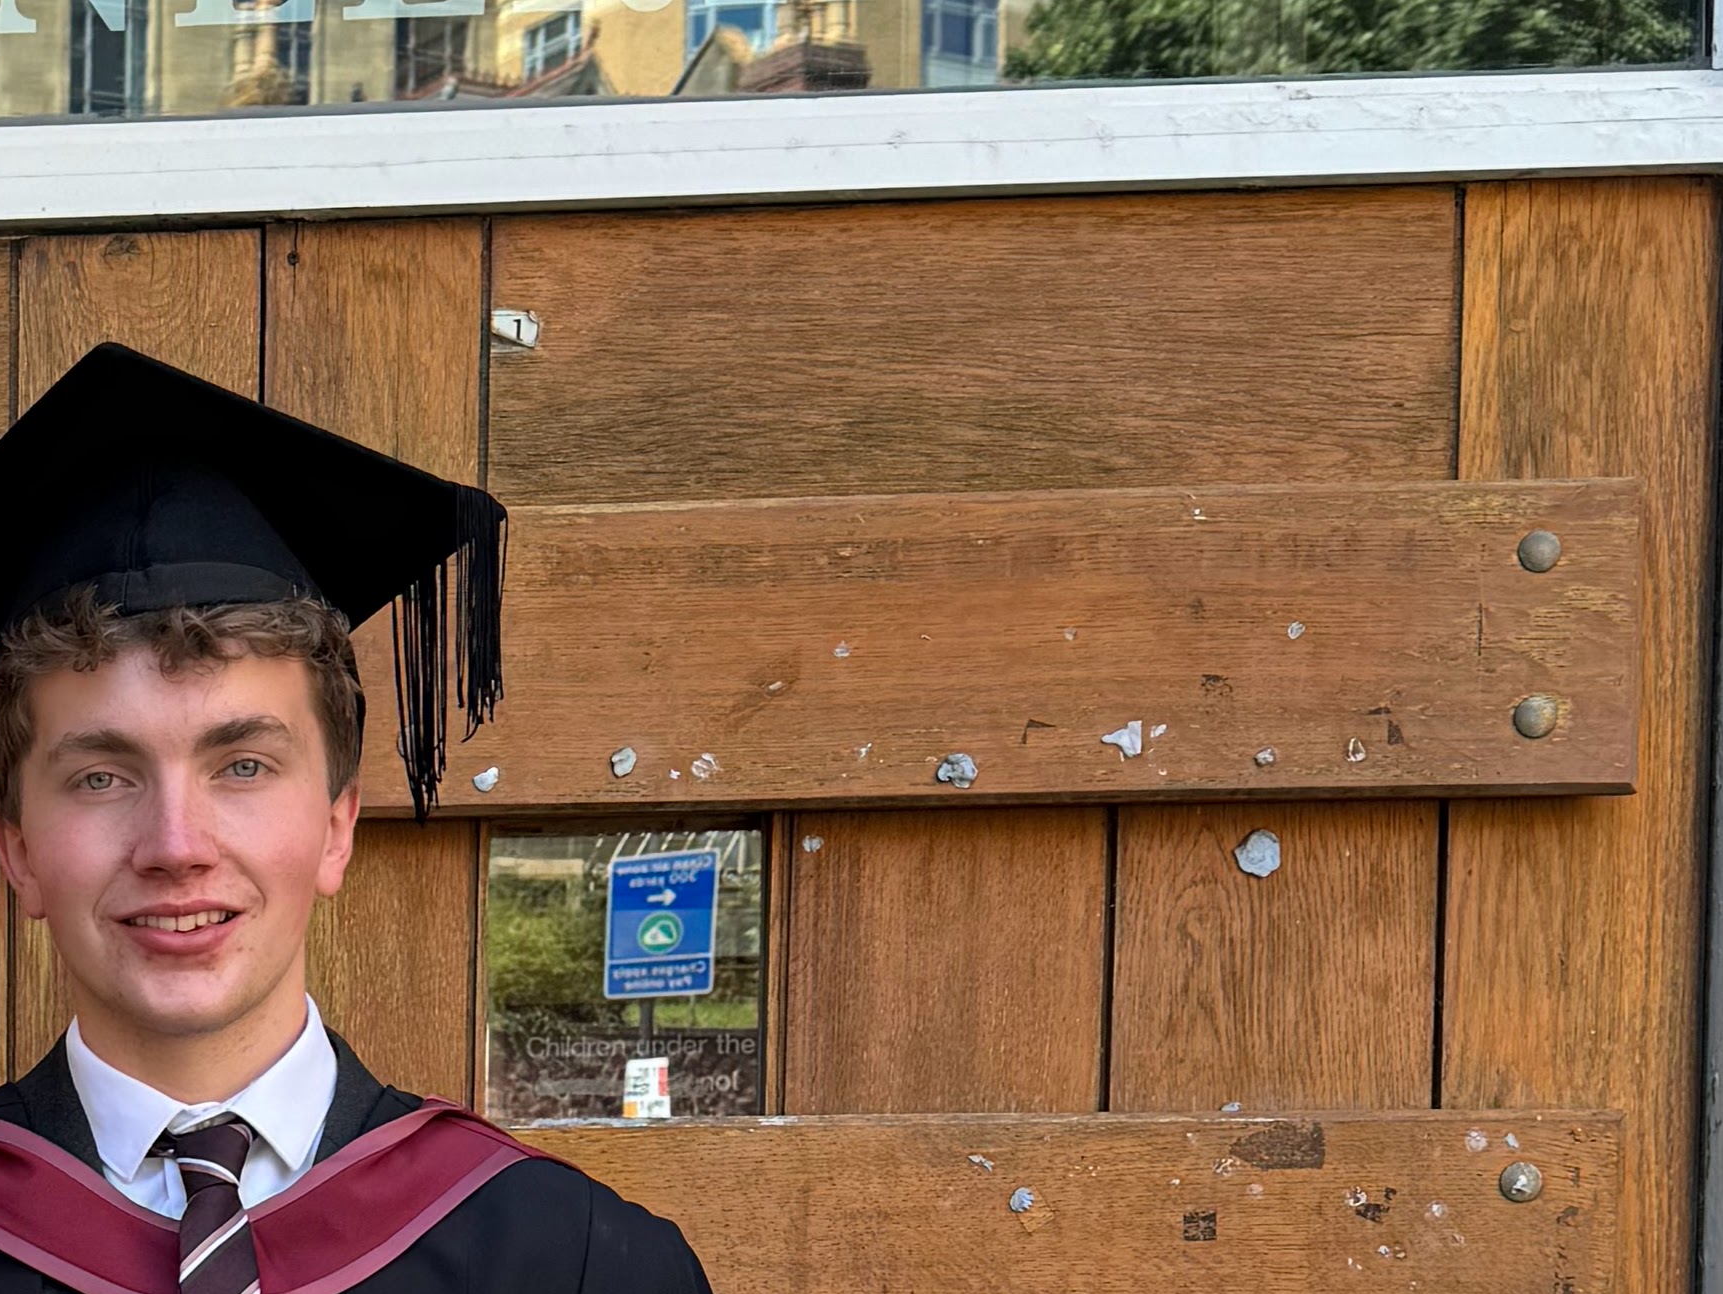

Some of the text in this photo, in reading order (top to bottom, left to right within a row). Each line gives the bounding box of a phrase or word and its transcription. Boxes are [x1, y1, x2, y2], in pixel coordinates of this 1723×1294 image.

[525, 1033, 756, 1058] Children under the
